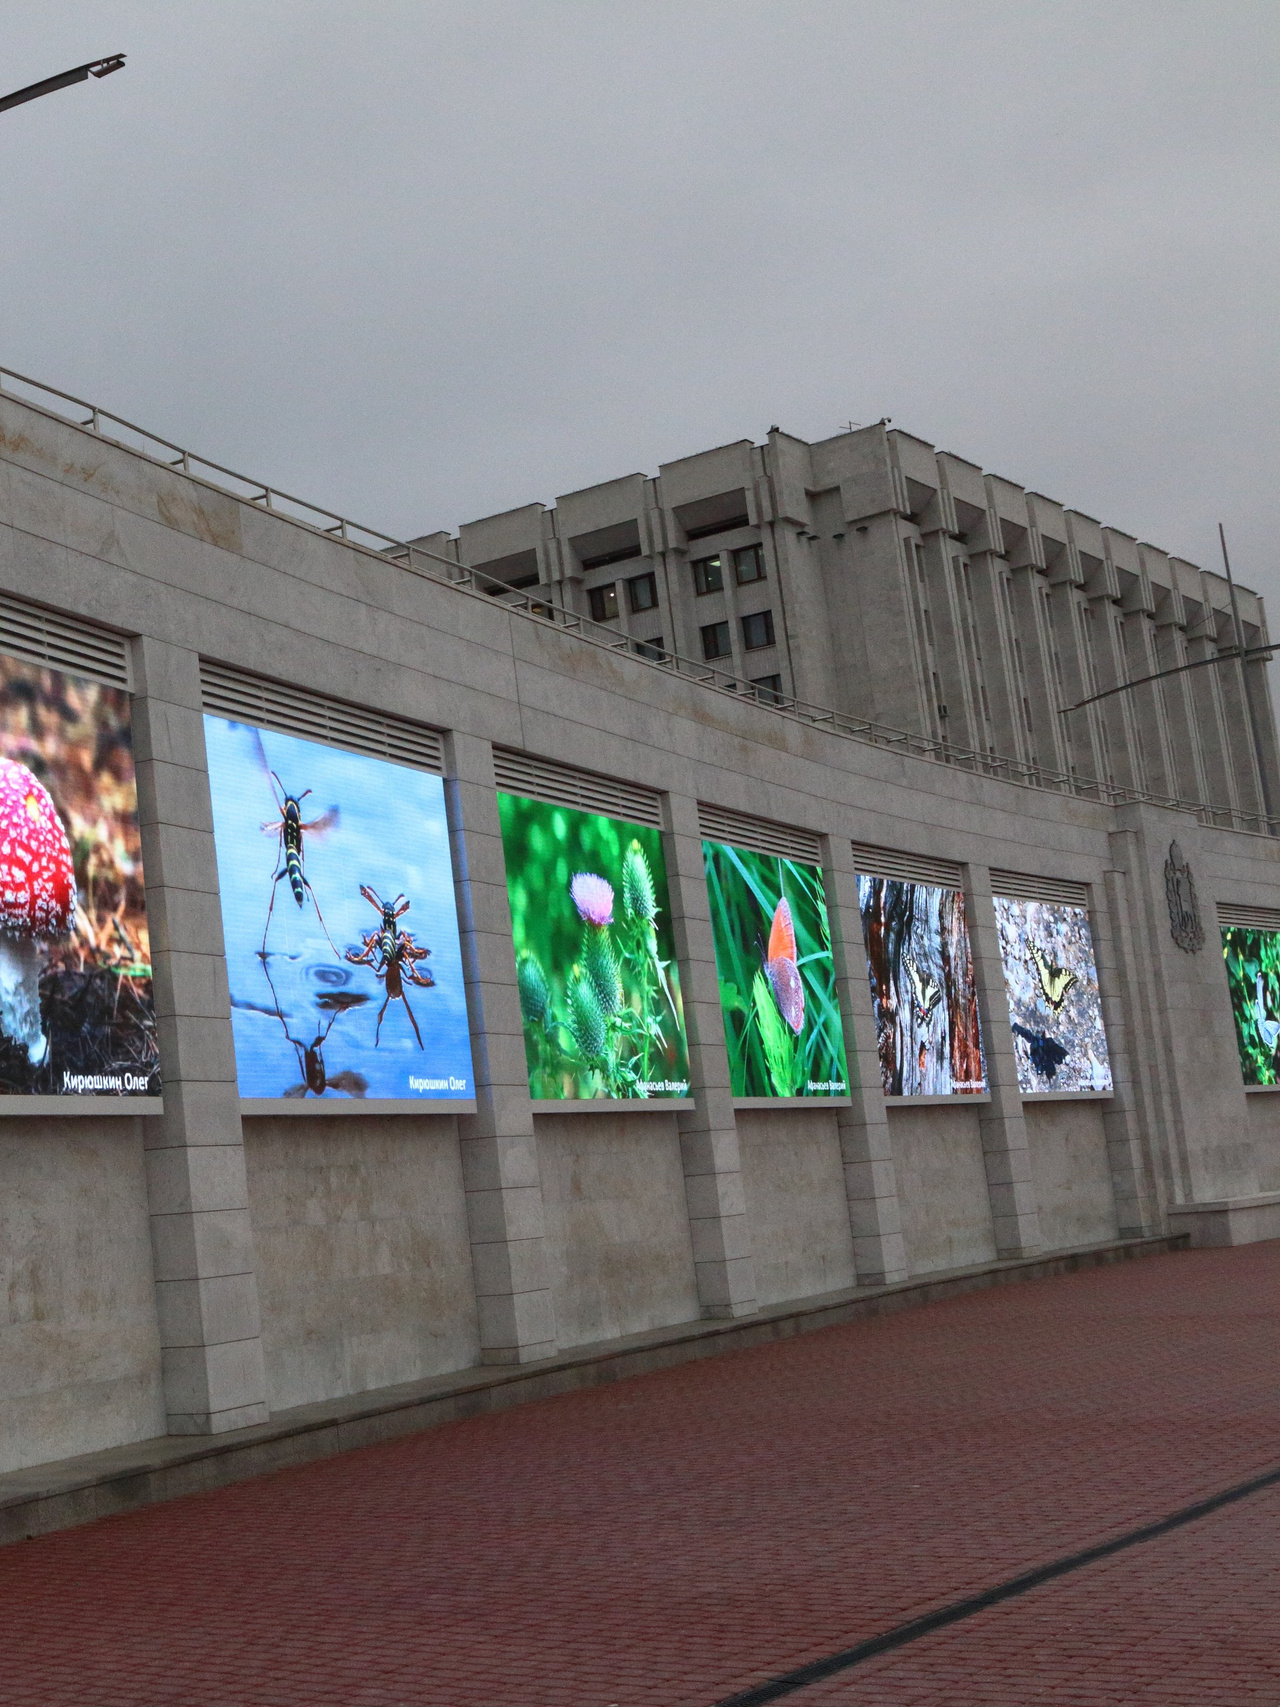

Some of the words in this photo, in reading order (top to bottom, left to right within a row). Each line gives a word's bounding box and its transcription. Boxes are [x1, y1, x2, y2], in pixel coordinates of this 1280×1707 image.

[63, 1071, 123, 1093] Кирюшкин
[124, 1072, 150, 1090] Олег
[409, 1075, 449, 1093] Кирюшкин
[449, 1076, 467, 1091] Олег
